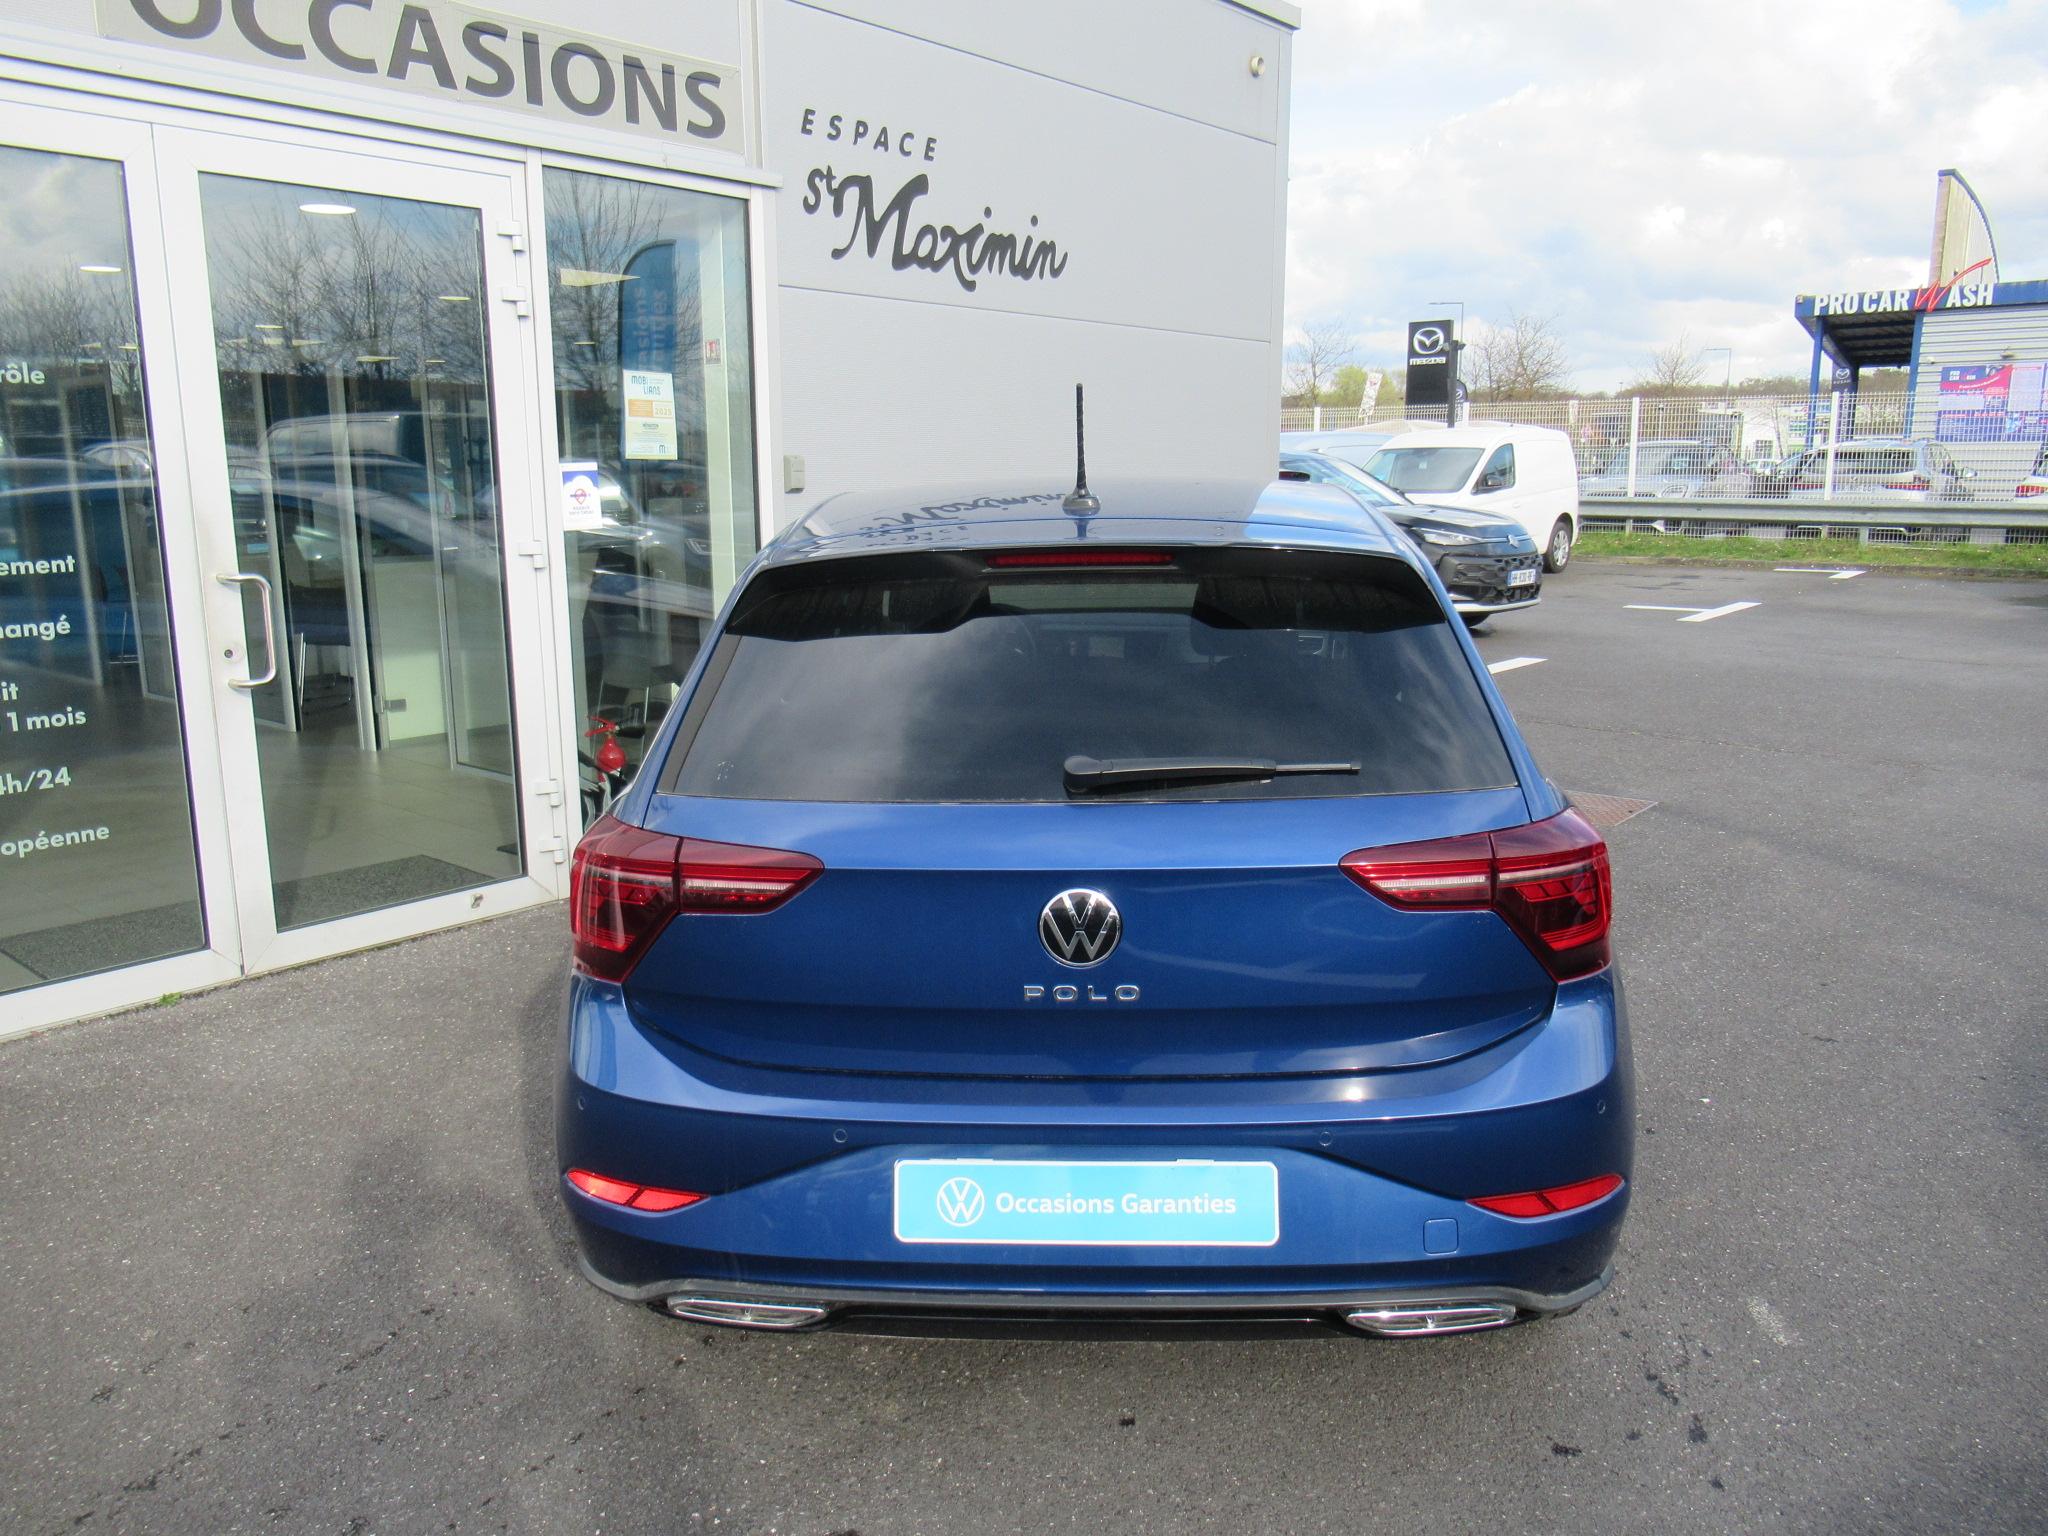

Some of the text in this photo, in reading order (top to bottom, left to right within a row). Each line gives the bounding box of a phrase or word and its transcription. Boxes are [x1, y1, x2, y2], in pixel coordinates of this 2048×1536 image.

[801, 108, 938, 162] ESPACE
[831, 173, 1069, 292] Maximin
[1813, 259, 1995, 317] PRO CAR WASH
[6, 706, 87, 733] 1 mois
[1023, 985, 1141, 1002] POLO
[995, 1192, 1237, 1215] Occasions Garanties
